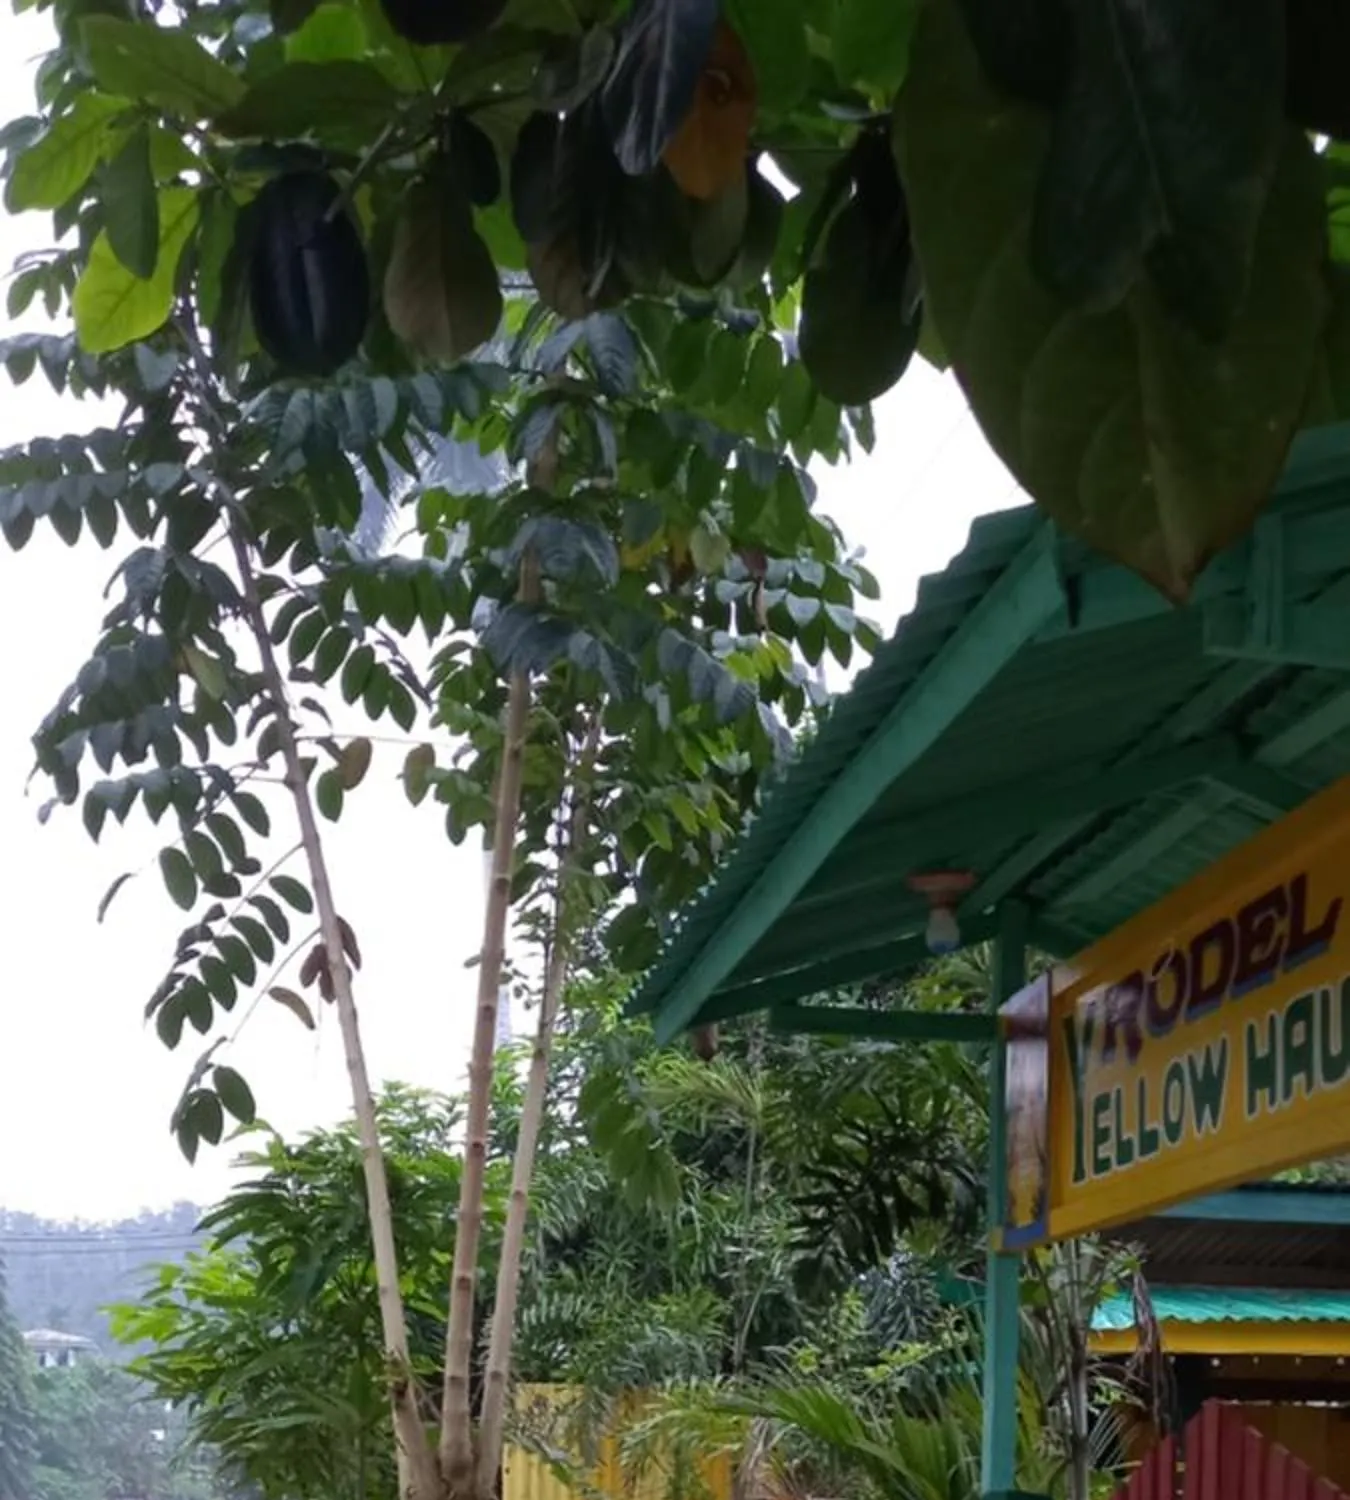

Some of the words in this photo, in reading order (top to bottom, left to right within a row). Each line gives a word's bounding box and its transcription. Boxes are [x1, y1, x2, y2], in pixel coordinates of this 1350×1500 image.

[1101, 872, 1344, 1066] RODEL
[1061, 1012, 1228, 1185] YELLOW
[1245, 973, 1350, 1117] HAU
